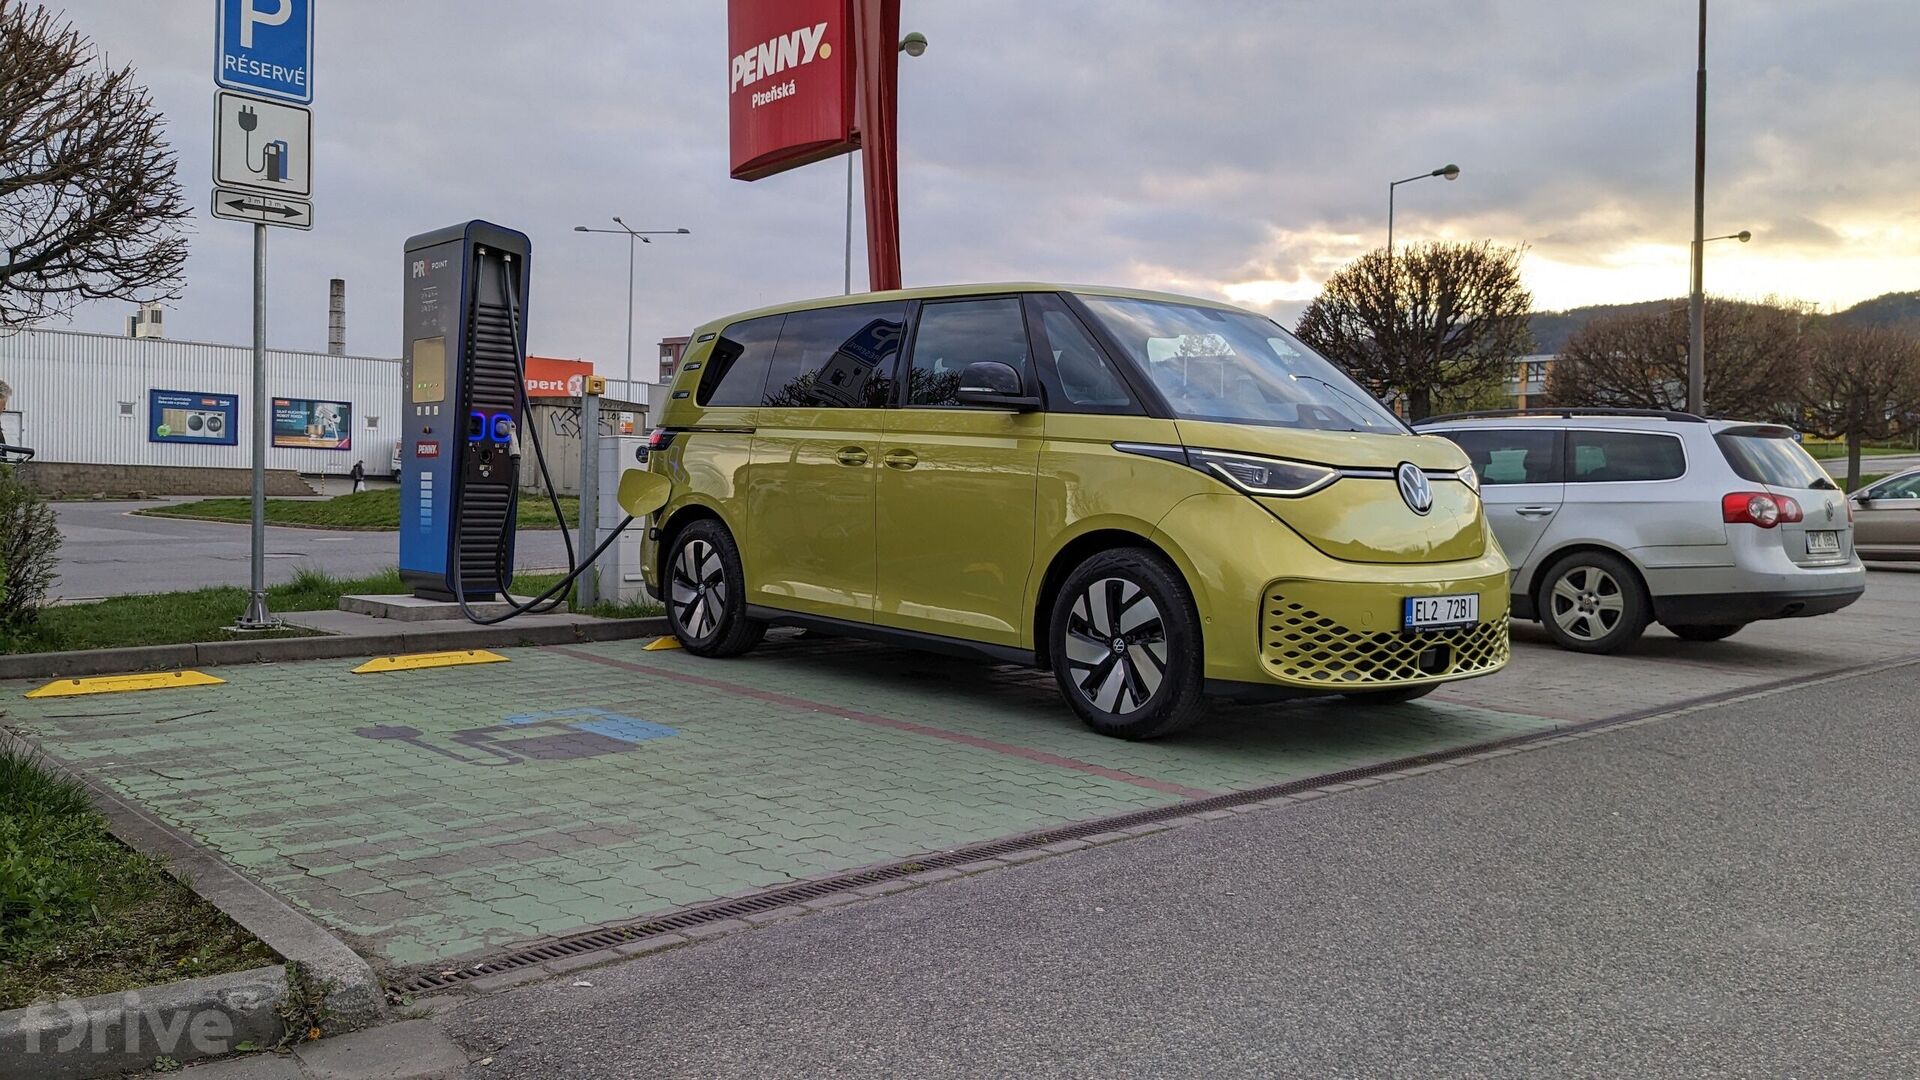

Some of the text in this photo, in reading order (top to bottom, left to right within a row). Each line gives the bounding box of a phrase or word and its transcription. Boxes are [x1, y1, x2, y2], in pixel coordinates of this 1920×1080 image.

[225, 54, 305, 85] RÉSERVÉ
[752, 79, 796, 108] Plzeňská
[431, 259, 448, 271] POINT
[1415, 600, 1439, 622] EL2
